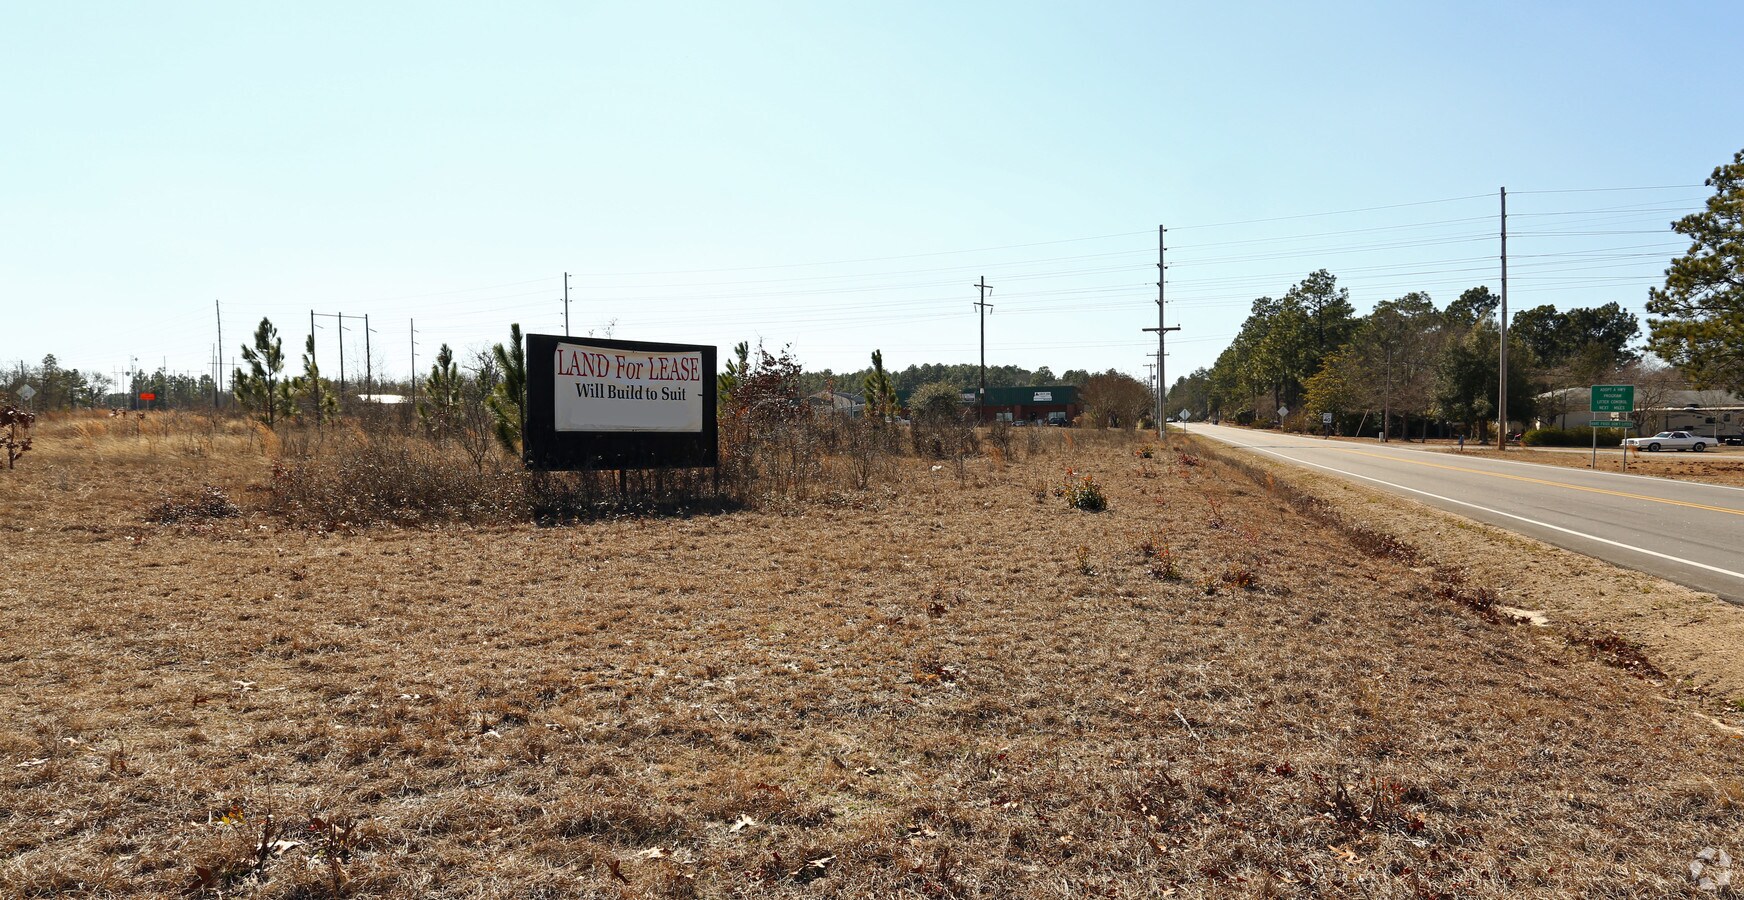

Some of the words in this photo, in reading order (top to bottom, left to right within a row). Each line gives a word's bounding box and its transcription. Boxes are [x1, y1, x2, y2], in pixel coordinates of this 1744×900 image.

[557, 349, 610, 378] LAND
[615, 355, 643, 379] For
[648, 357, 700, 382] LEASE
[576, 383, 604, 398] Will
[608, 384, 643, 400] Build
[646, 387, 658, 400] to
[661, 387, 686, 401] Suit
